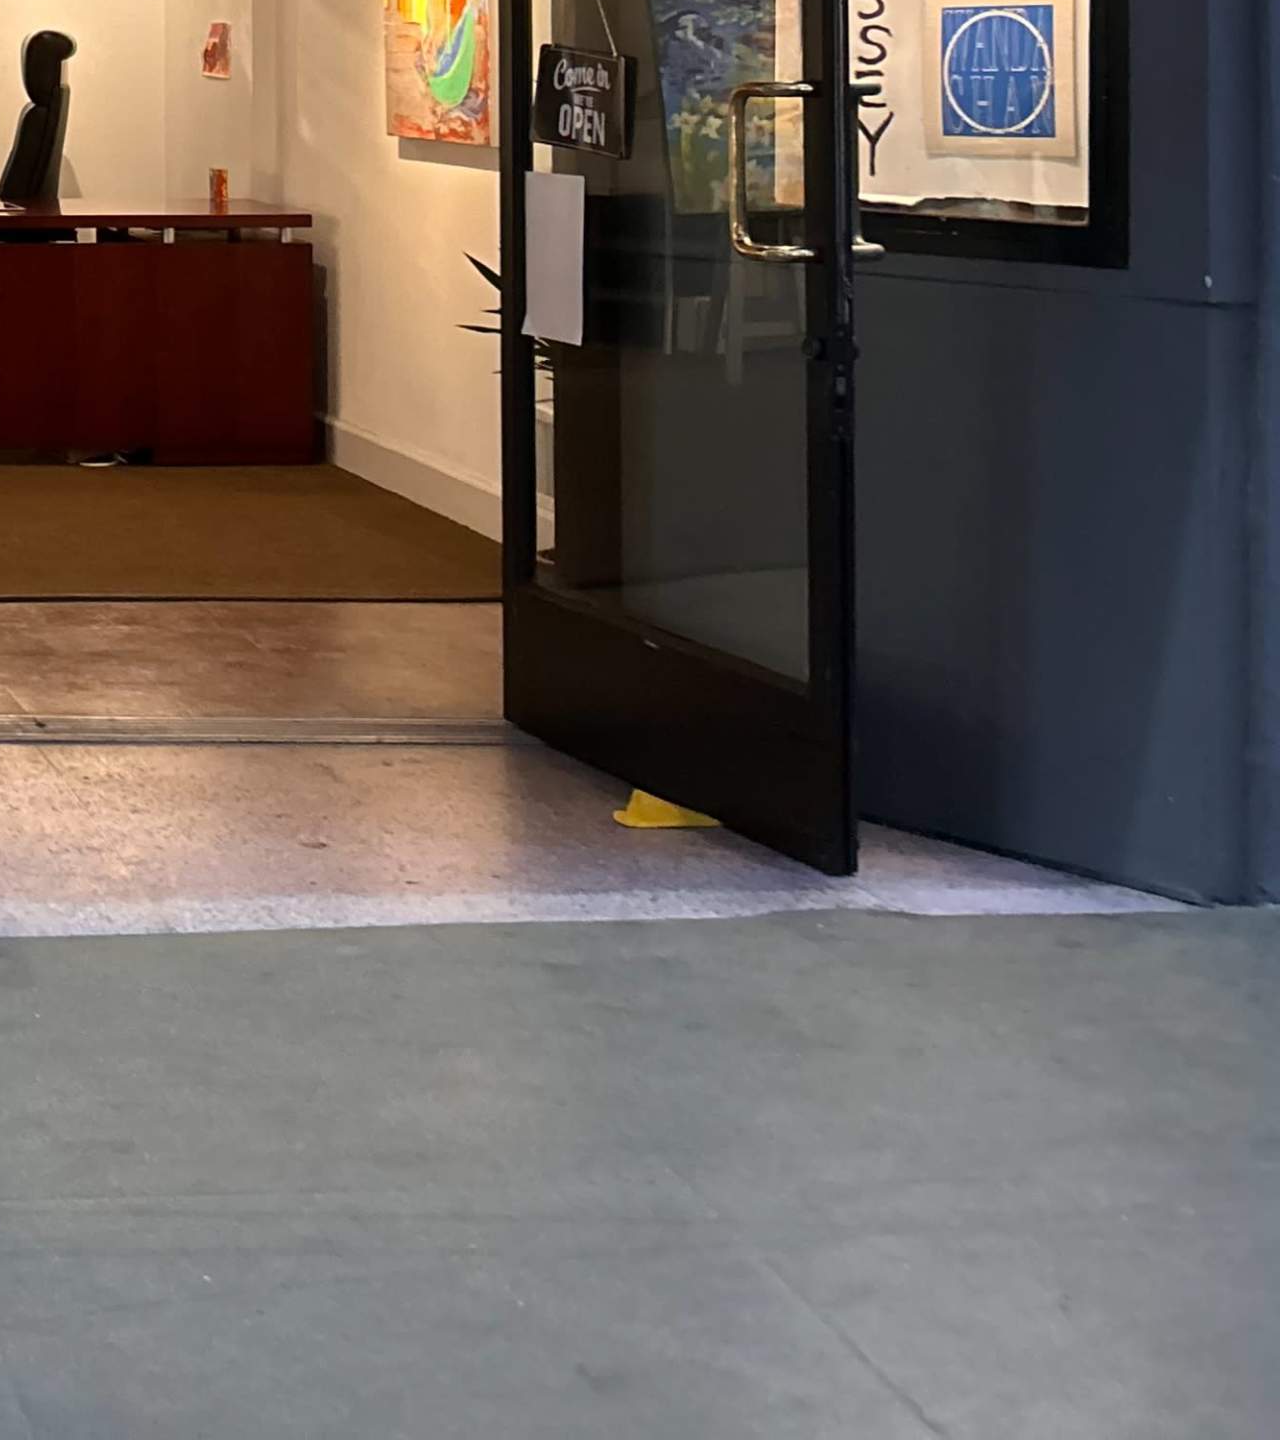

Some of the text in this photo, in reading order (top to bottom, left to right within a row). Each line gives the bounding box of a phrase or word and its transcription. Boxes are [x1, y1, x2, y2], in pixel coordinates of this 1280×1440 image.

[553, 58, 611, 91] Come in
[558, 103, 606, 147] OPEN
